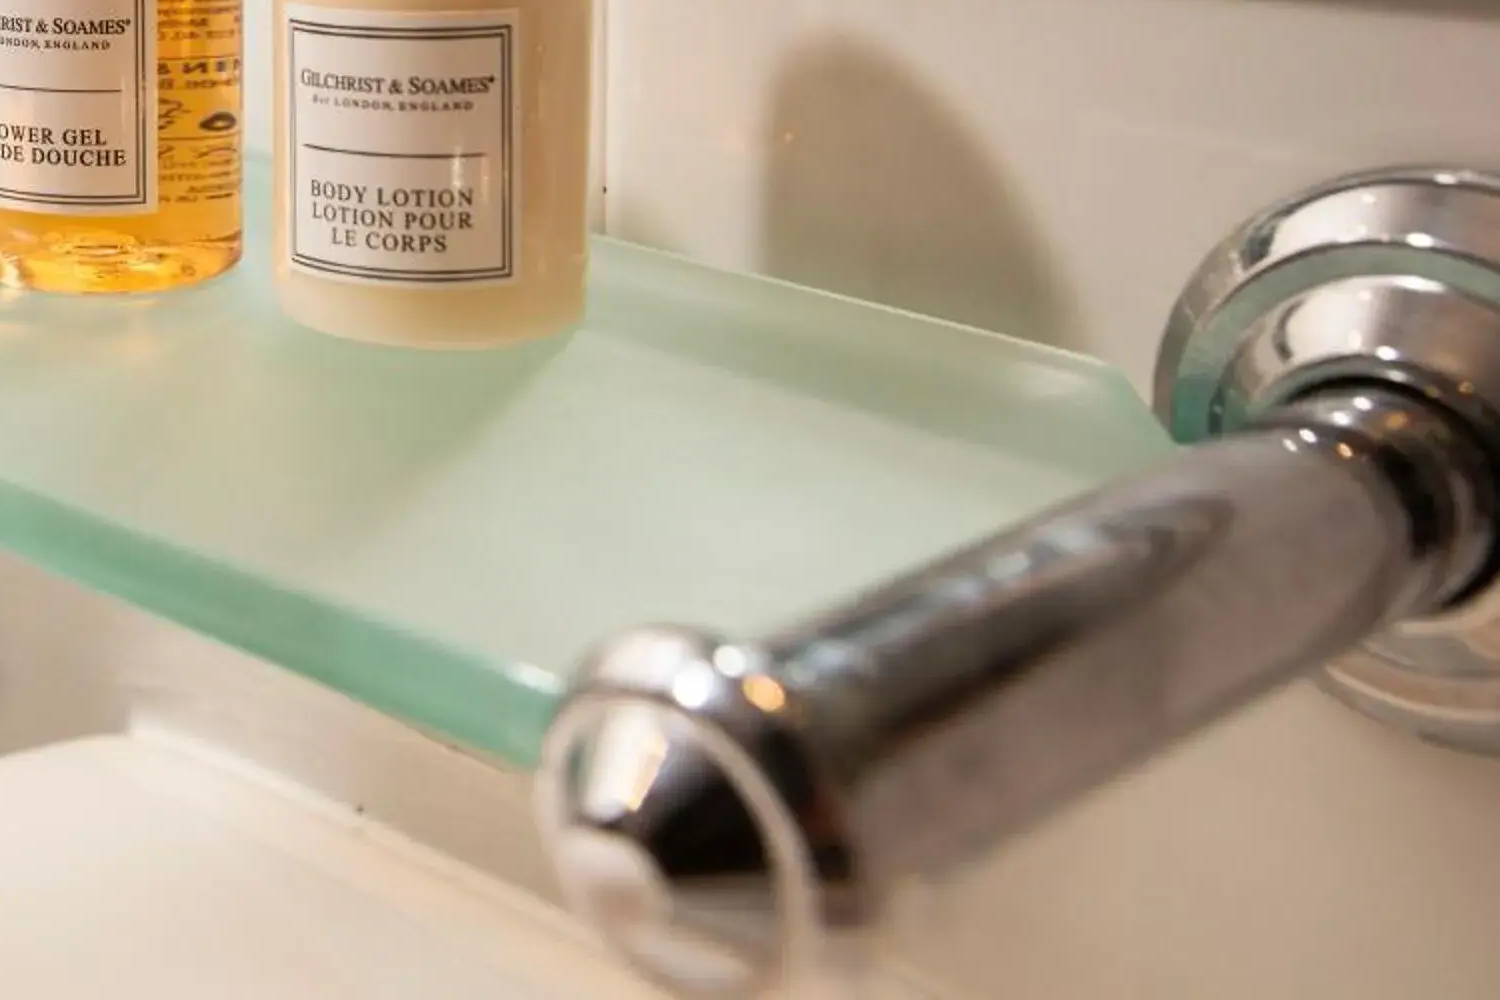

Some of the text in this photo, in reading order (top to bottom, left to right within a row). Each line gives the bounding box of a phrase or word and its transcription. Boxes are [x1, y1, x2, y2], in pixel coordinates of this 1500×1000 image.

[36, 19, 49, 34] &
[301, 68, 386, 94] GILCHRIST
[388, 77, 403, 95] &
[398, 100, 475, 112] ENGLAND
[62, 128, 107, 146] GEL
[0, 143, 25, 161] DE
[31, 147, 126, 167] DOUCHE
[311, 179, 474, 208] BODY LOTION
[312, 201, 473, 231] LOTION POUR
[332, 226, 448, 253] LE CORPS
